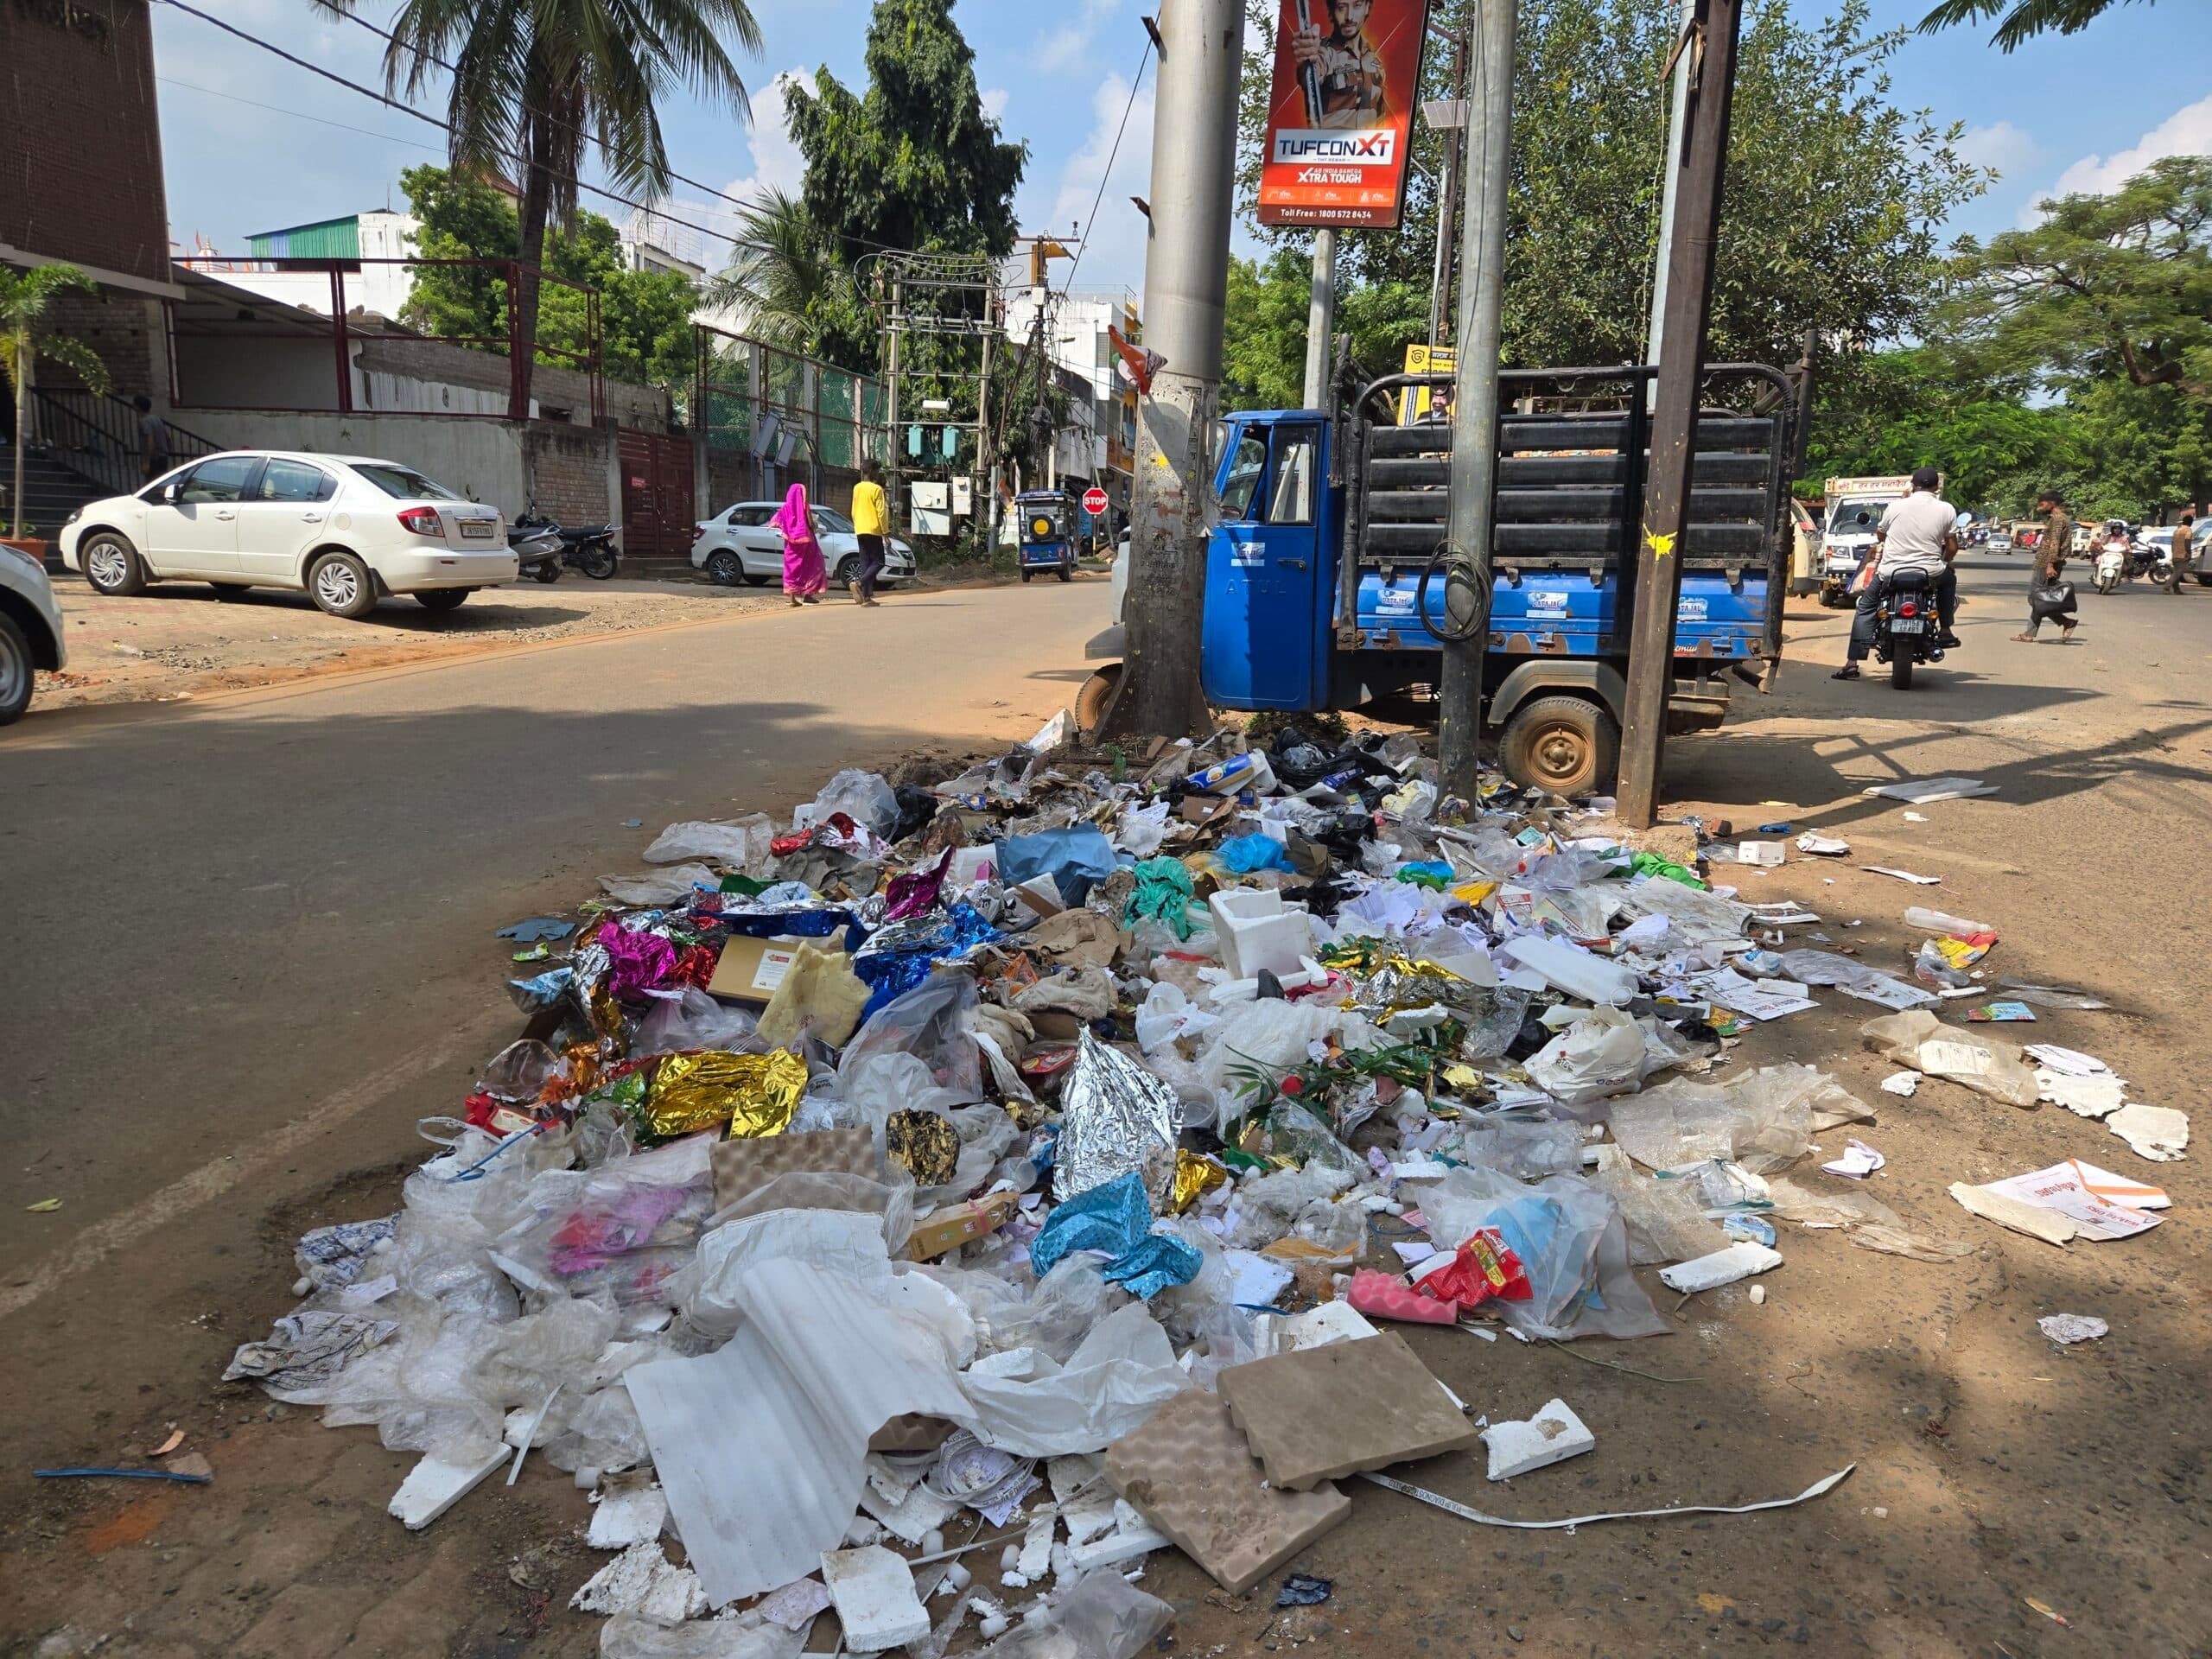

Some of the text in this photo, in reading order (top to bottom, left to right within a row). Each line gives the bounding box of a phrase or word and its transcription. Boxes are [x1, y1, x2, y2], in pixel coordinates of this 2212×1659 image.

[1297, 167, 1363, 184] XTRA TOUGH
[1281, 208, 1371, 219] Toll Free: 1800 572 8434
